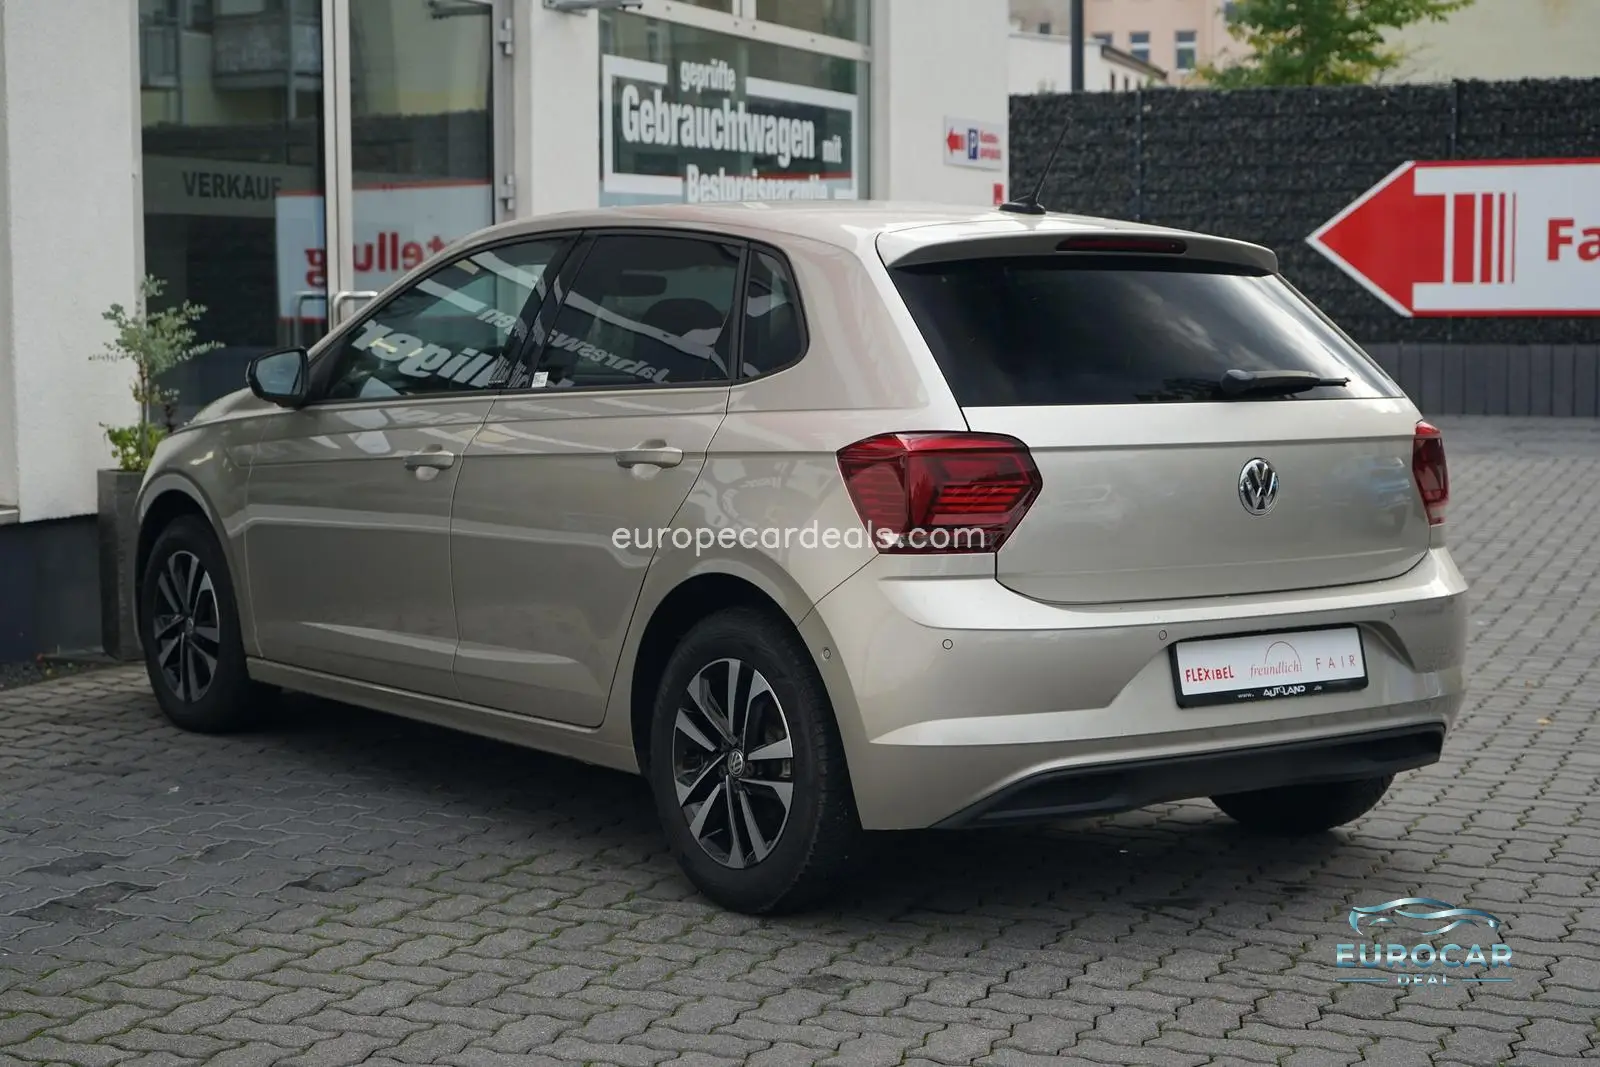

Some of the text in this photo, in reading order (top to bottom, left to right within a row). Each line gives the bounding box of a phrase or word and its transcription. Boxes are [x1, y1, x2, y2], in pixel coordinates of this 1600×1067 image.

[680, 59, 736, 93] geprüfte
[621, 85, 843, 168] Gebrauchtwagen mit
[181, 171, 282, 200] VERKAUF
[1185, 665, 1235, 682] FLEXIBEL
